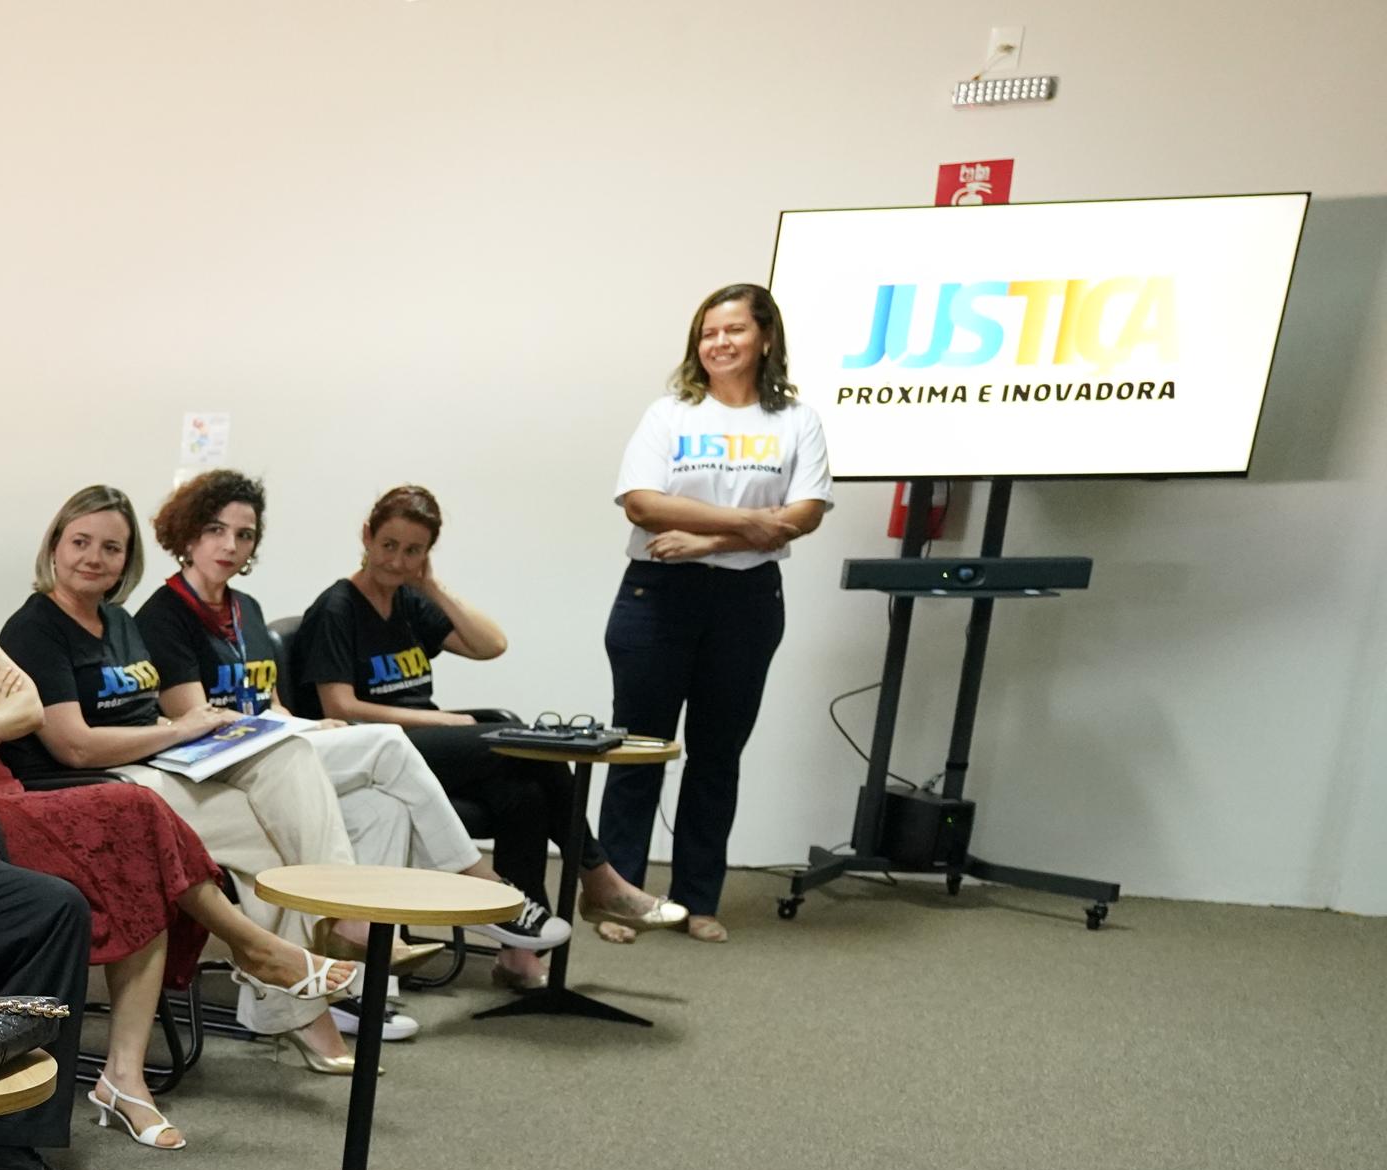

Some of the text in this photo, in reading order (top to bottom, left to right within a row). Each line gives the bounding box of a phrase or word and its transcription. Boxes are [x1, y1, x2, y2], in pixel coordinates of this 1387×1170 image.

[841, 275, 1180, 377] JUSTIÇA
[836, 380, 1176, 405] PRÓXIMA E INOVADORA
[673, 434, 781, 463] JUSTIÇA
